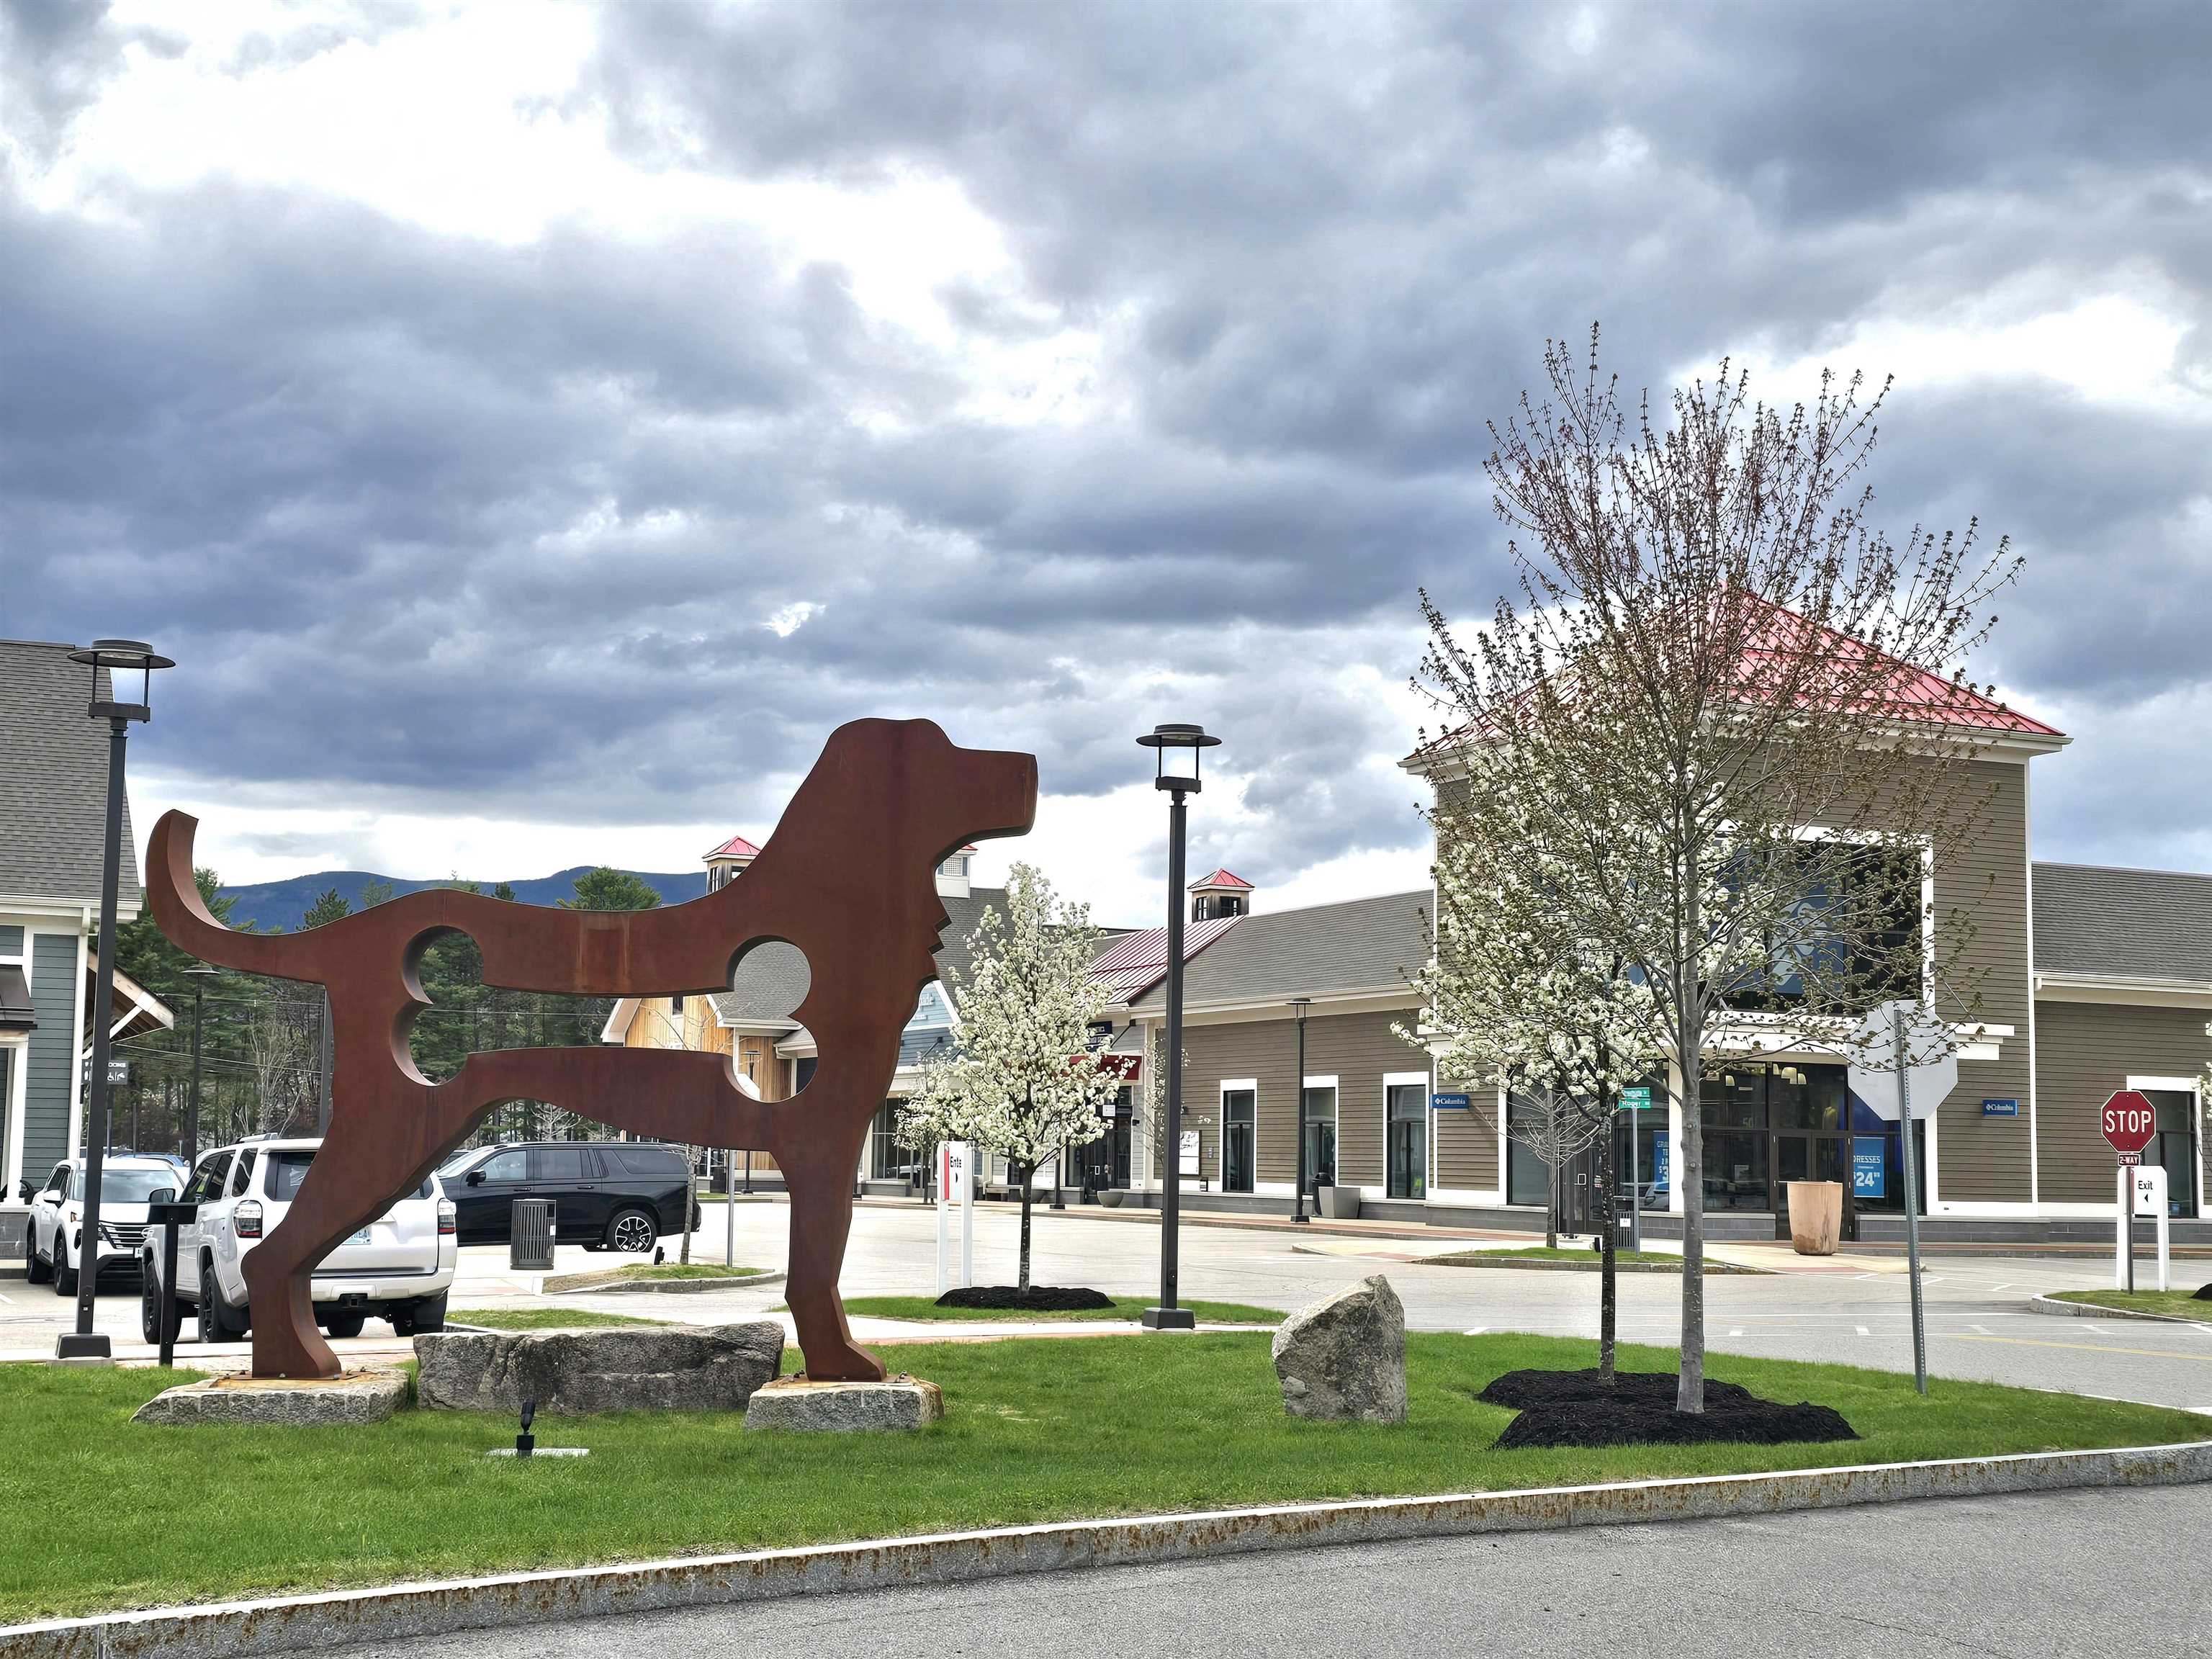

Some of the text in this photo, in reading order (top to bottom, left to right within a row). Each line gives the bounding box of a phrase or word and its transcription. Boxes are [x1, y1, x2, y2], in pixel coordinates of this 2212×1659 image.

[2105, 1110, 2152, 1133] STOP
[2119, 1156, 2139, 1164] 2-WAY
[2138, 1180, 2153, 1190] Exit
